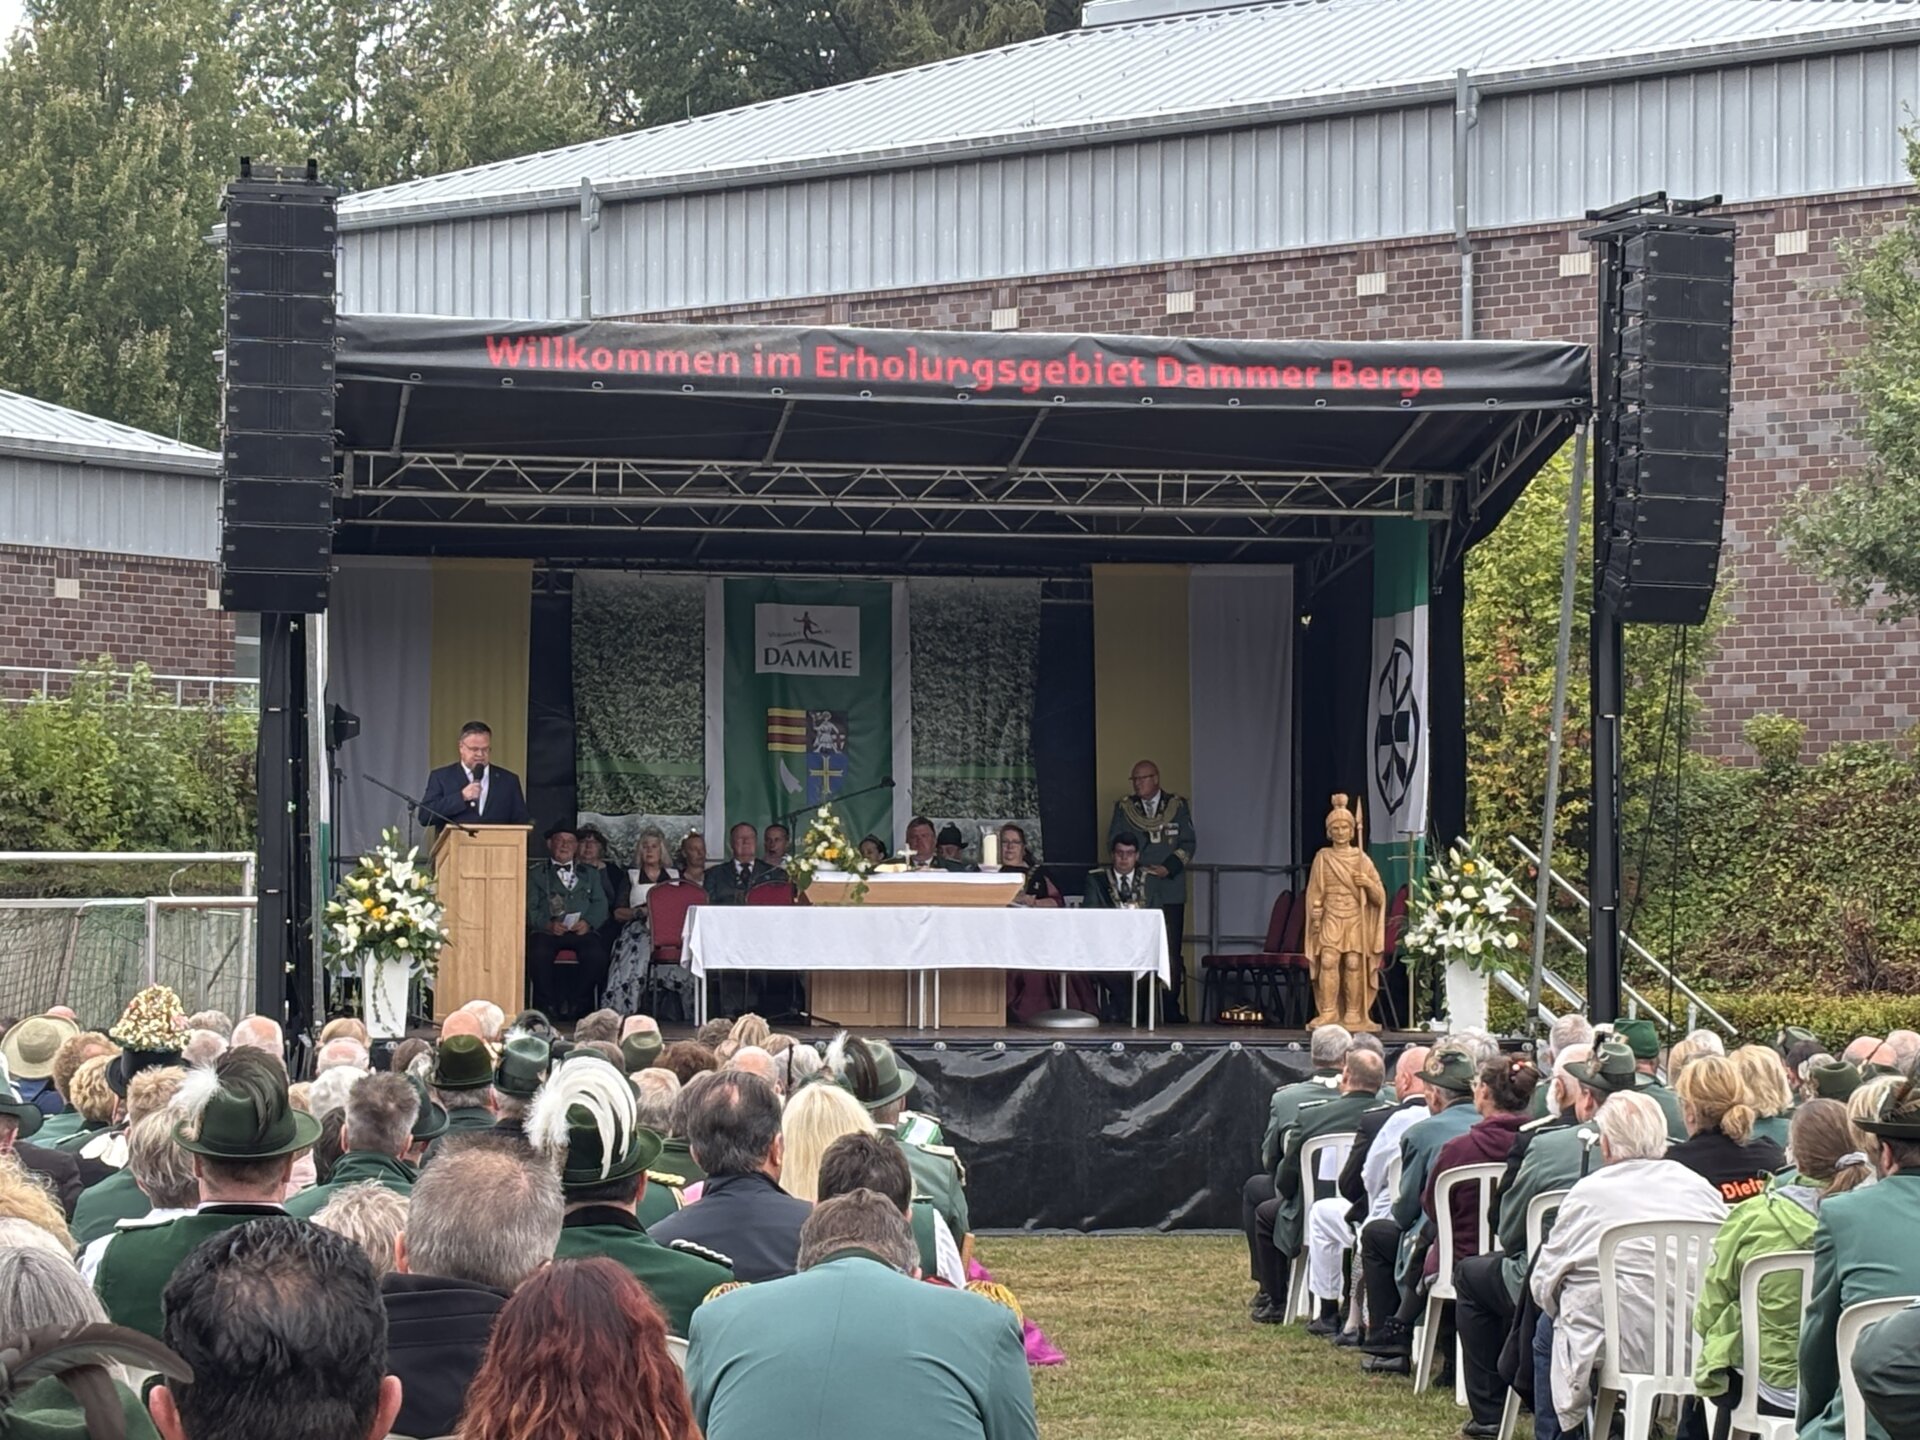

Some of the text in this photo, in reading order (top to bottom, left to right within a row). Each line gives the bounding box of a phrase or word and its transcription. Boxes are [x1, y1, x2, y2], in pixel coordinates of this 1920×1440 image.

[486, 335, 1444, 397] Willkommen im Erholungsgebiet Dammer Berge
[763, 647, 853, 669] DAMME
